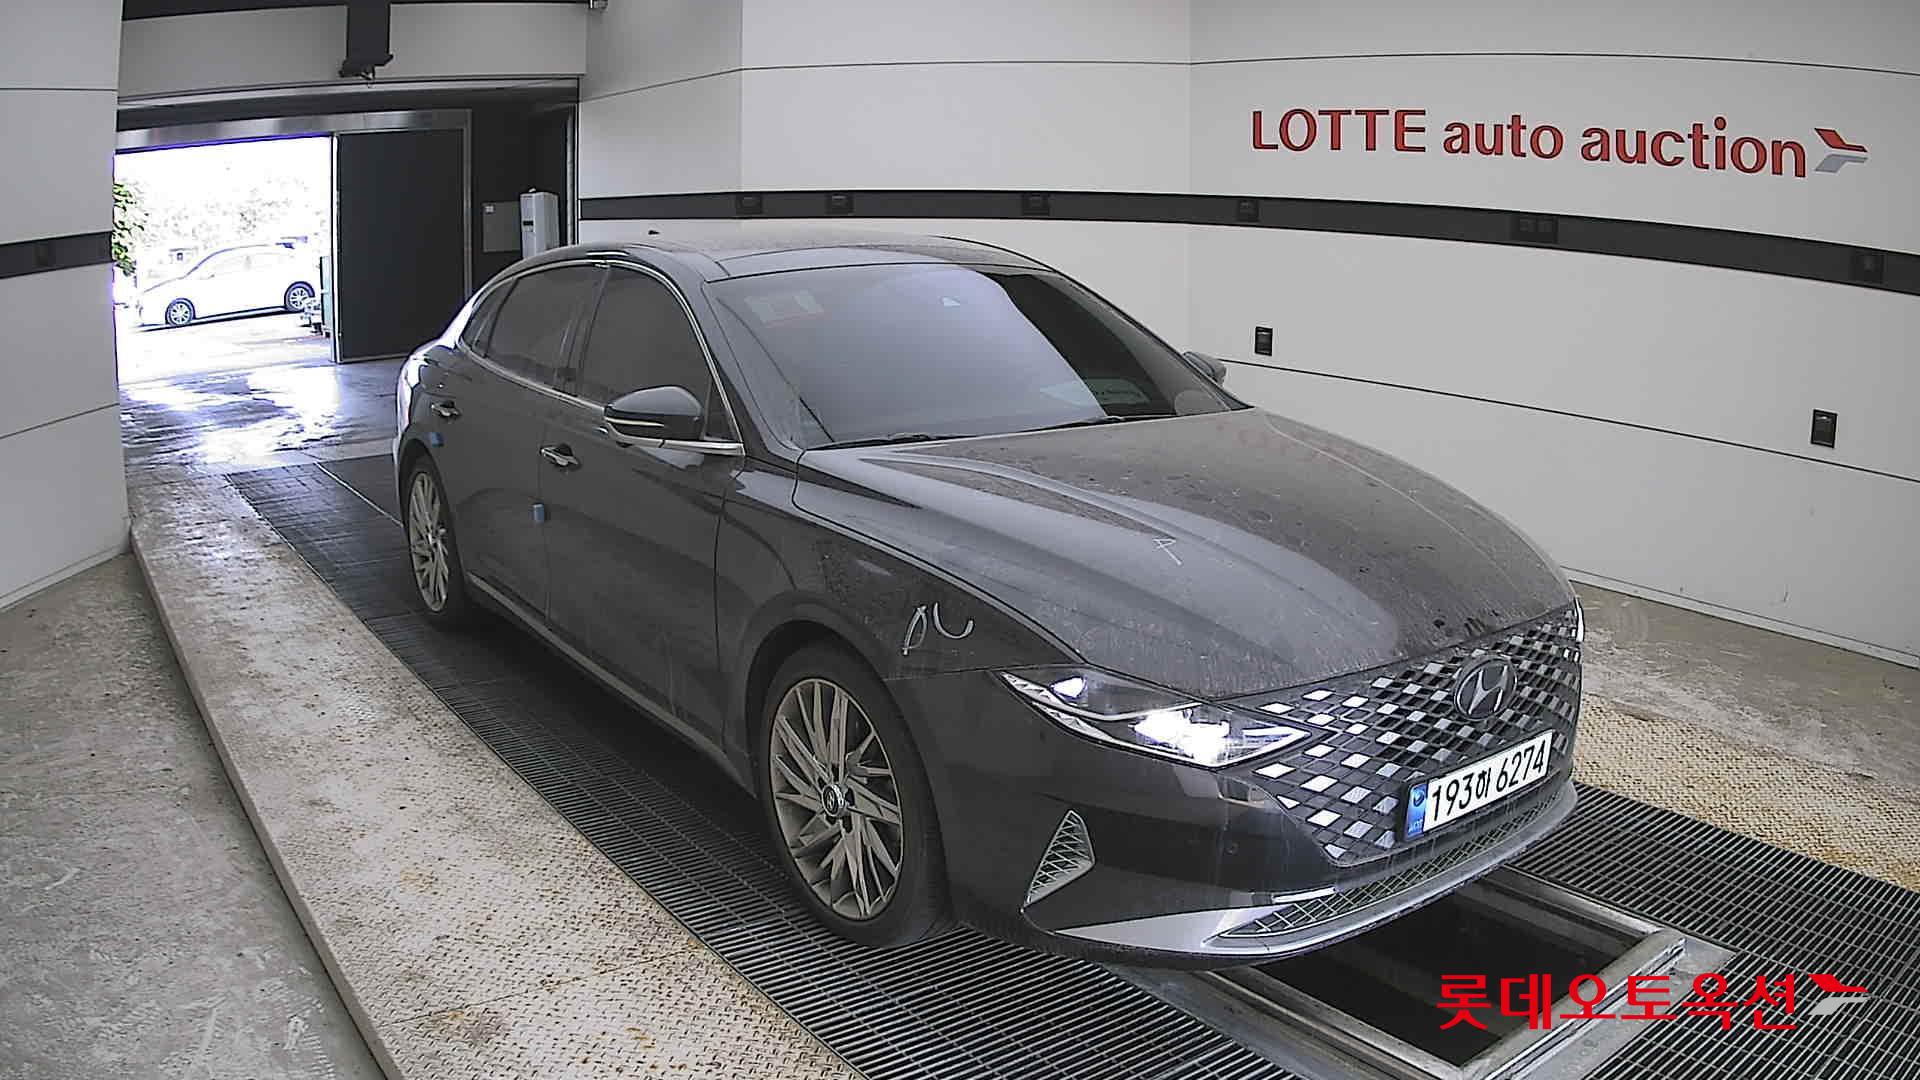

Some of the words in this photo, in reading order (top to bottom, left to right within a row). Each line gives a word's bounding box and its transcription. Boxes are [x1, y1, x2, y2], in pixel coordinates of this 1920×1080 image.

[1252, 108, 1427, 152] LOTTE
[1443, 114, 1564, 159] auto
[1580, 116, 1807, 178] auction
[1431, 767, 1492, 822] 193하
[1496, 739, 1546, 793] 6274
